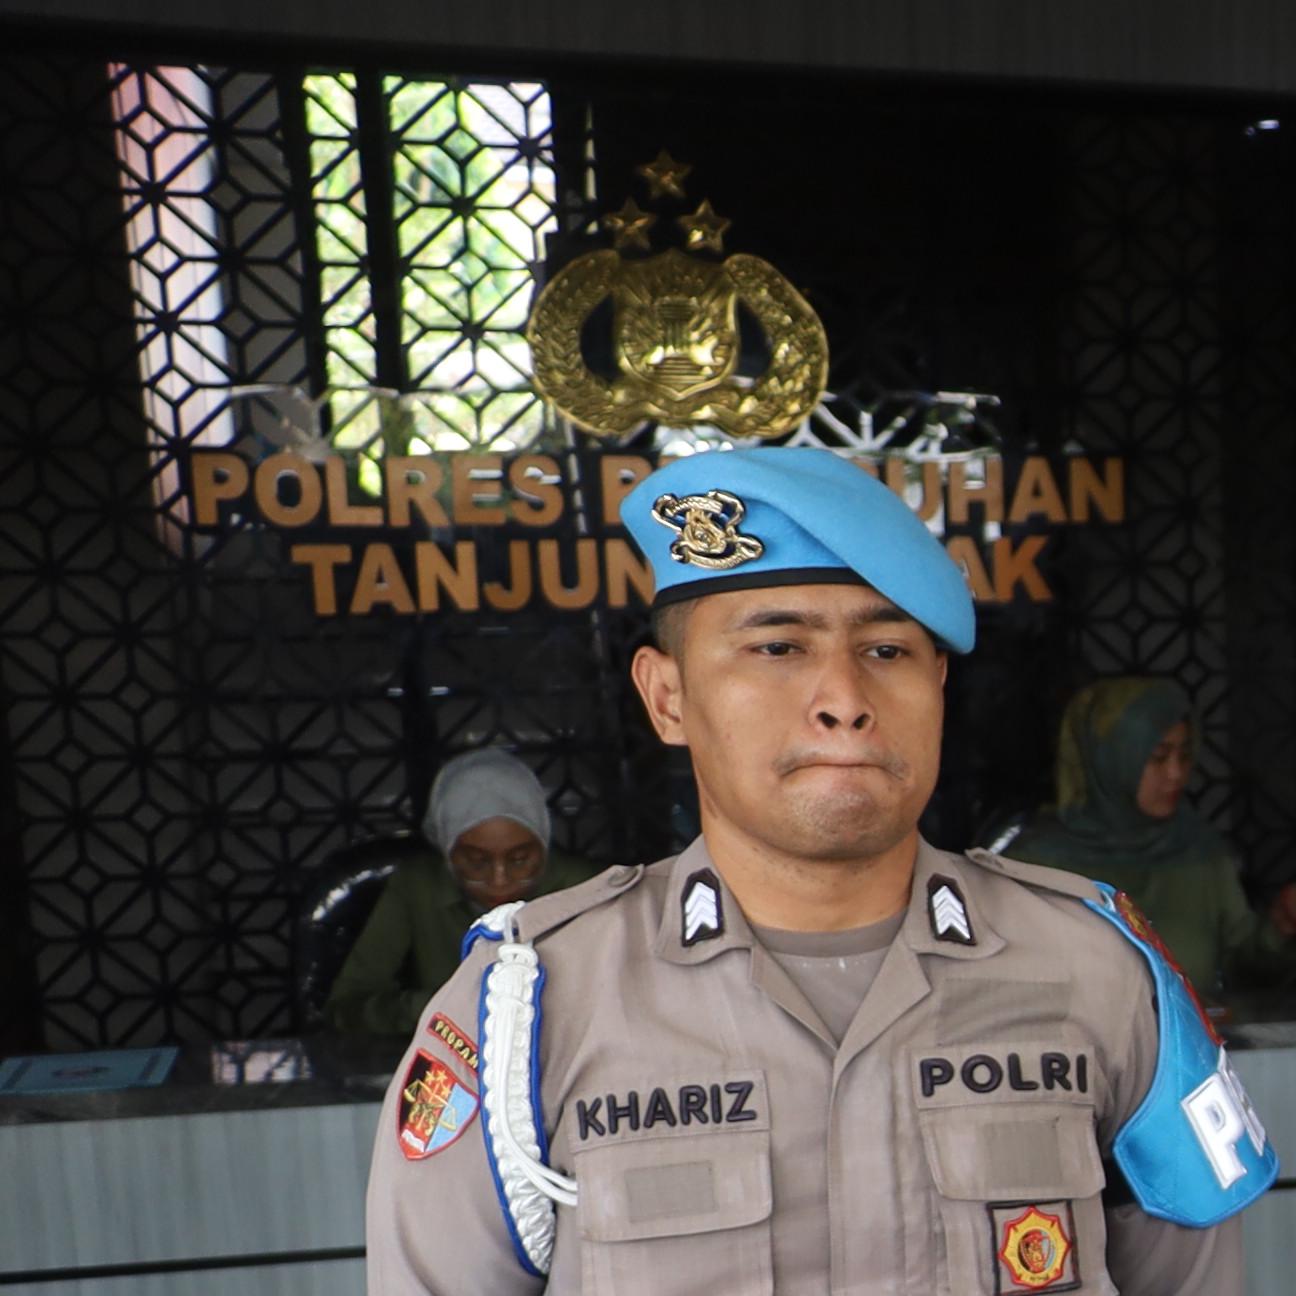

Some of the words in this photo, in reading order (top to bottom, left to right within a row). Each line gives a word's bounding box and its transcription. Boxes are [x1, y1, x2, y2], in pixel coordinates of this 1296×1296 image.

[191, 452, 565, 527] POLRES
[291, 538, 657, 616] TANJUN
[919, 1052, 1088, 1097] POLRI
[576, 1081, 757, 1141] KHARIZ
